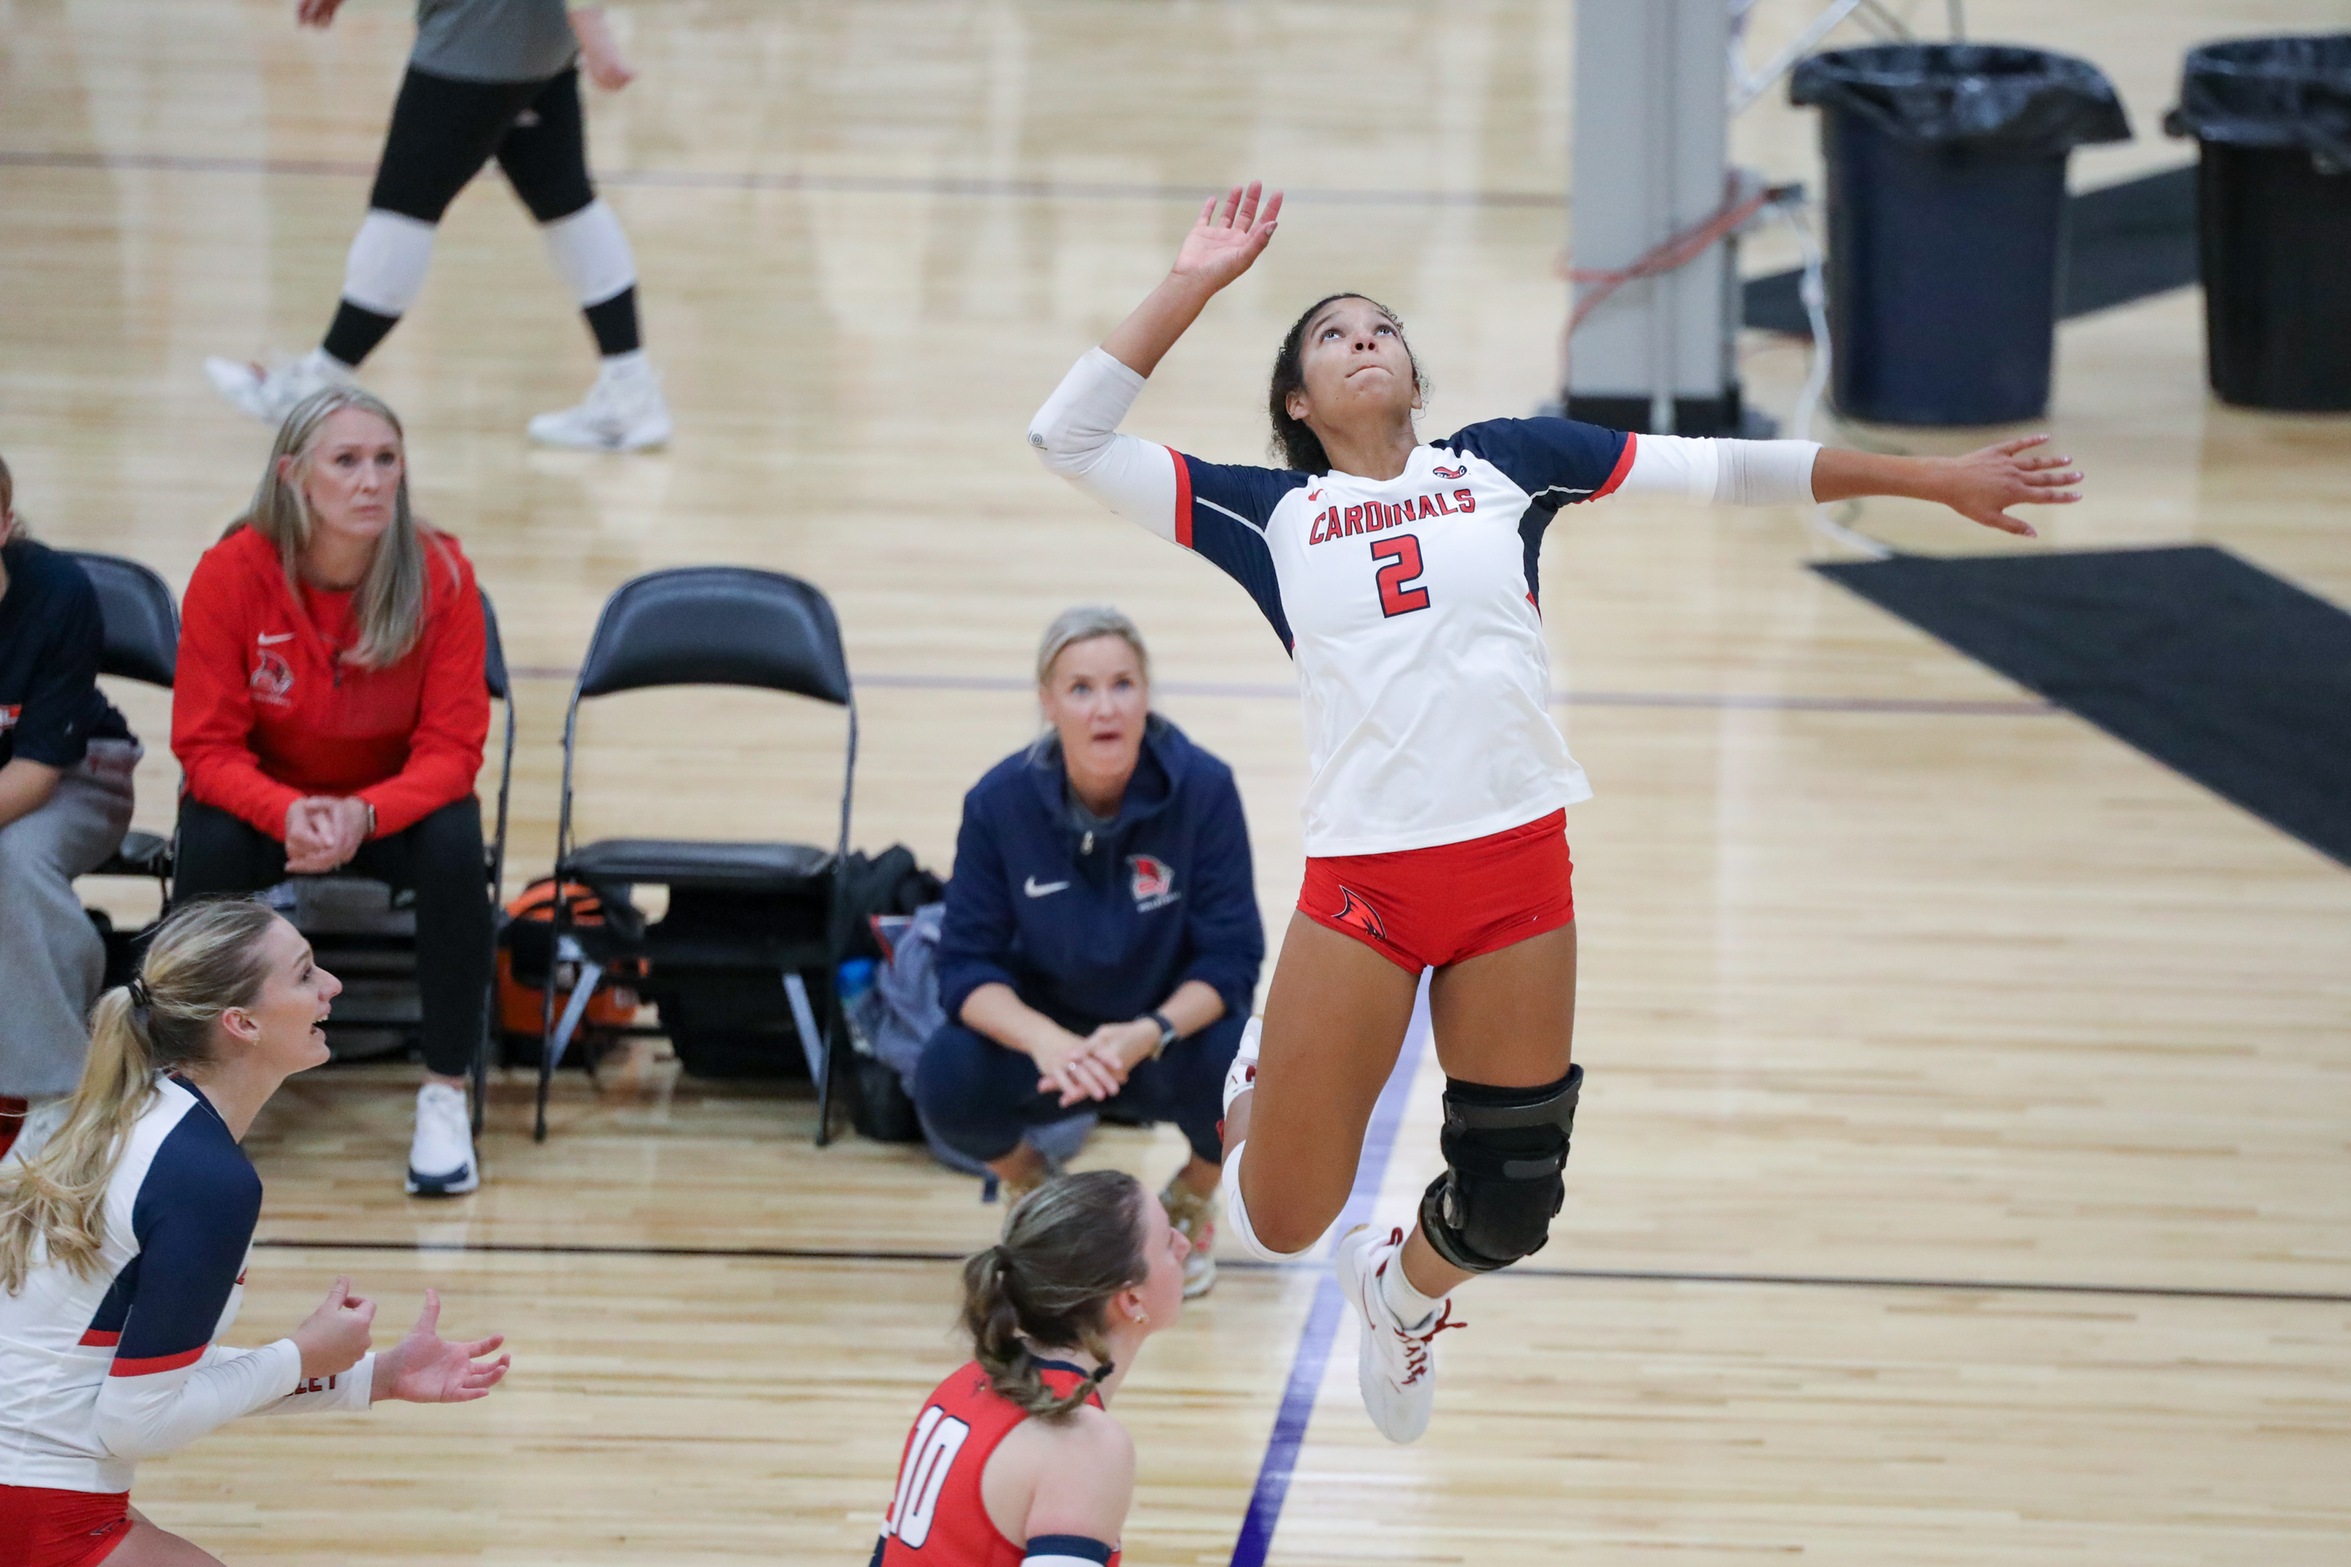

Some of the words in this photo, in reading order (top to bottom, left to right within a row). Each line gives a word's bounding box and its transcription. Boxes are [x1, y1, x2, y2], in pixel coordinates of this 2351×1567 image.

[1309, 488, 1476, 546] CARDINALS
[1370, 533, 1431, 619] 2
[888, 1403, 971, 1551] 10
